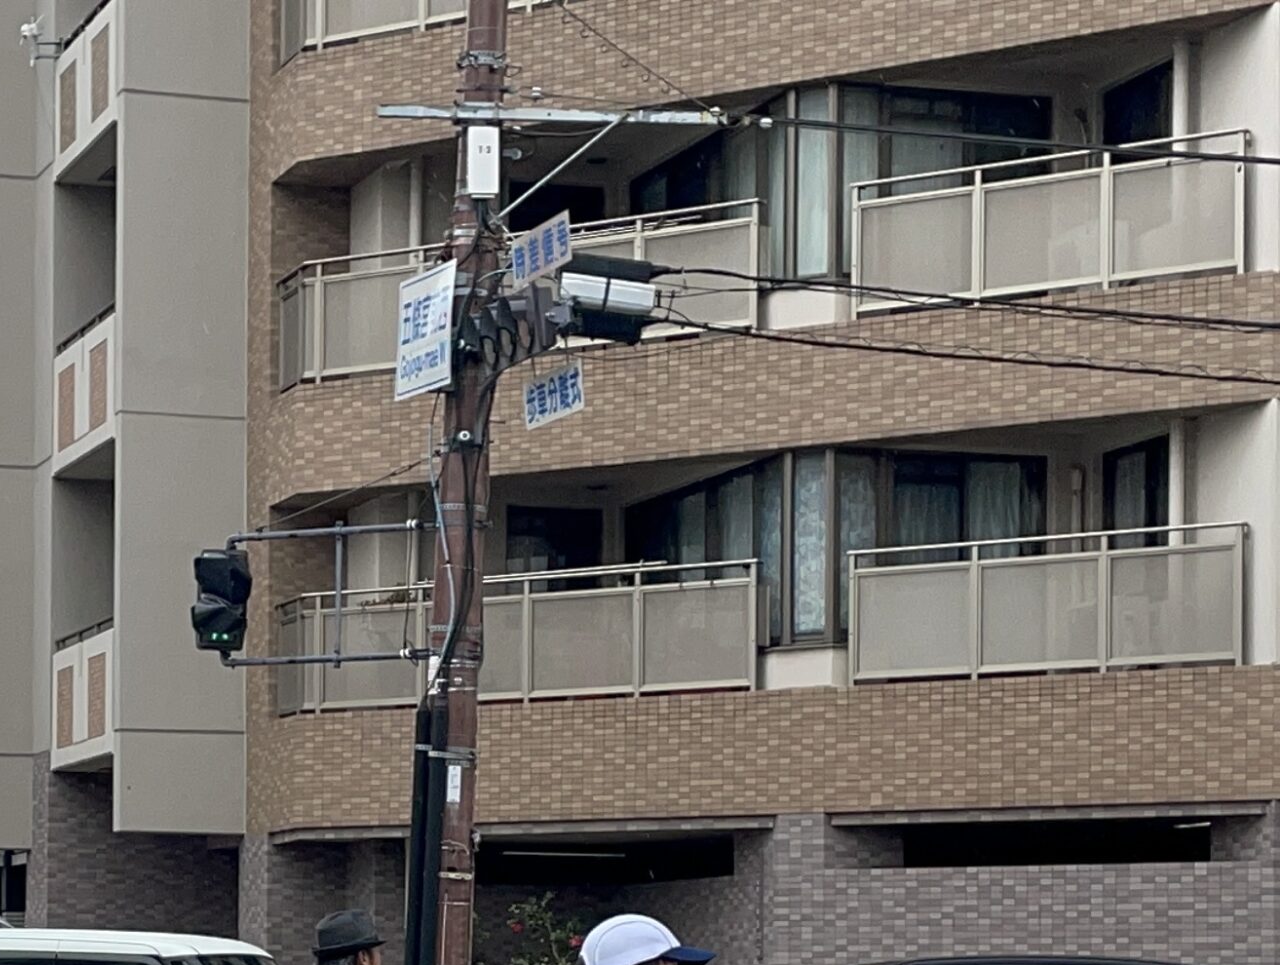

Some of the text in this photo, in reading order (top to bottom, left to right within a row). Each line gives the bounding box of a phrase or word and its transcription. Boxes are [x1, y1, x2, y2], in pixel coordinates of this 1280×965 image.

[526, 366, 582, 425] 歩車分離式
